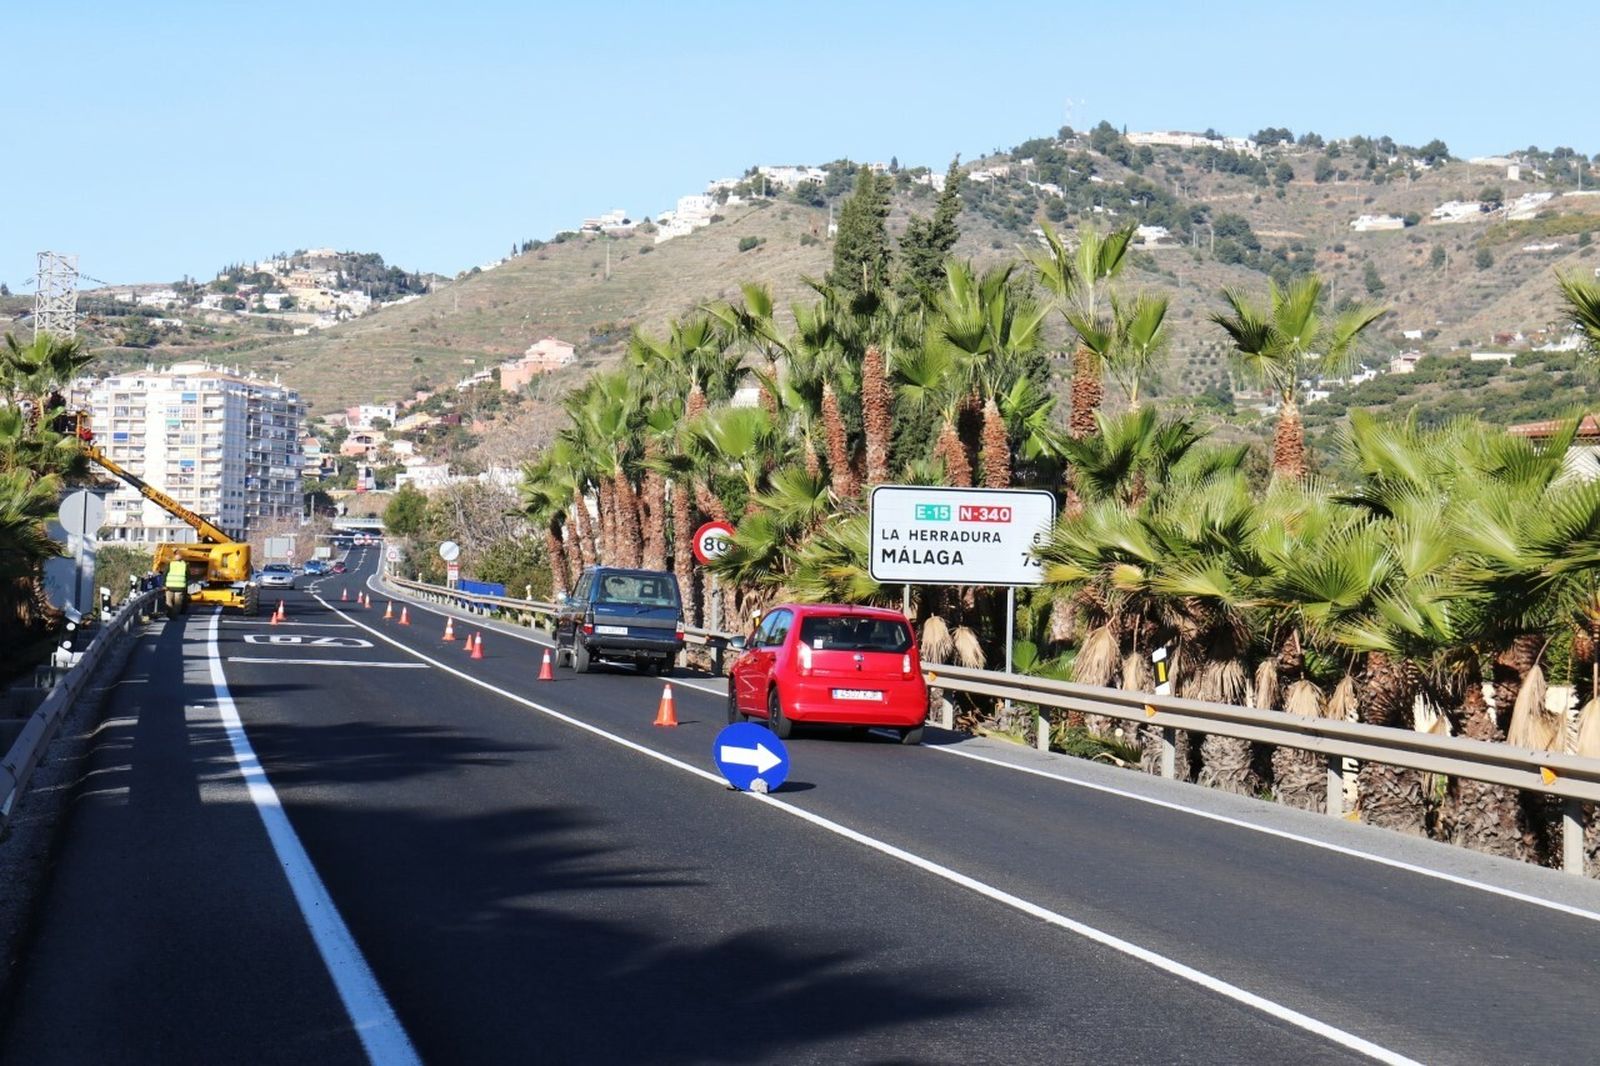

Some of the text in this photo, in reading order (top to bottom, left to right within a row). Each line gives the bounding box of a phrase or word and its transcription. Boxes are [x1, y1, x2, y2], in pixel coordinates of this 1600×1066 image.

[917, 506, 1010, 522] E-15 N-340
[881, 529, 900, 540] LA
[909, 530, 1002, 543] HERRADURA
[881, 545, 964, 566] MÁLAGA
